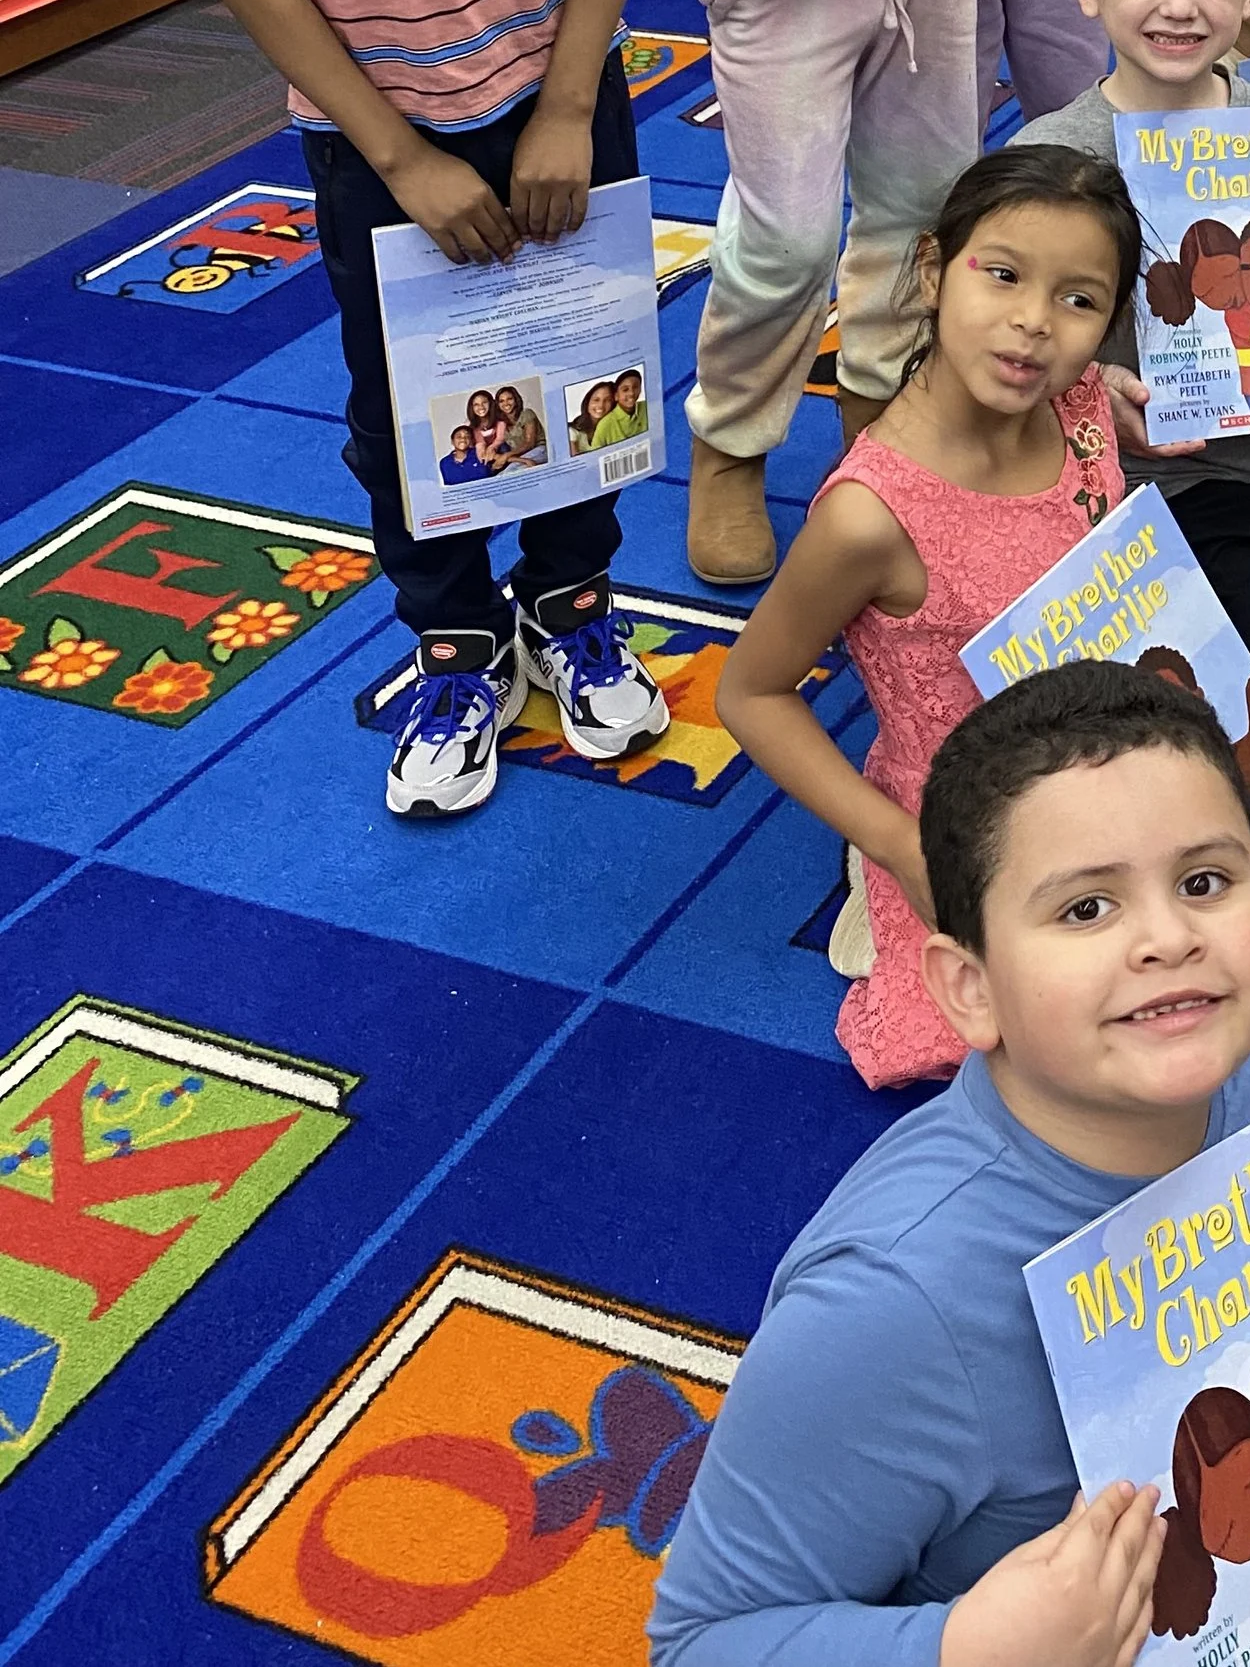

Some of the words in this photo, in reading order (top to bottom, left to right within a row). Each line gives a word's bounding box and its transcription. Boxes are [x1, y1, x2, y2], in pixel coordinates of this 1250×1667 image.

[1138, 130, 1186, 172] My
[1149, 350, 1199, 365] ROBINSON
[1202, 347, 1231, 359] PEETE
[1174, 337, 1204, 349] HOLLY
[1153, 374, 1176, 386] RYAN
[1180, 369, 1231, 383] ELIZABETH
[1178, 384, 1208, 397] PEETE
[1156, 409, 1187, 422] SHANE
[1204, 404, 1234, 417] EVANS
[31, 520, 242, 632] F
[991, 631, 1049, 688] My
[1041, 526, 1158, 645] Brother
[0, 1056, 302, 1321] K
[1067, 1260, 1144, 1343] My
[1190, 1620, 1222, 1655] written
[1222, 1611, 1235, 1631] by
[1196, 1627, 1241, 1667] HOLLY
